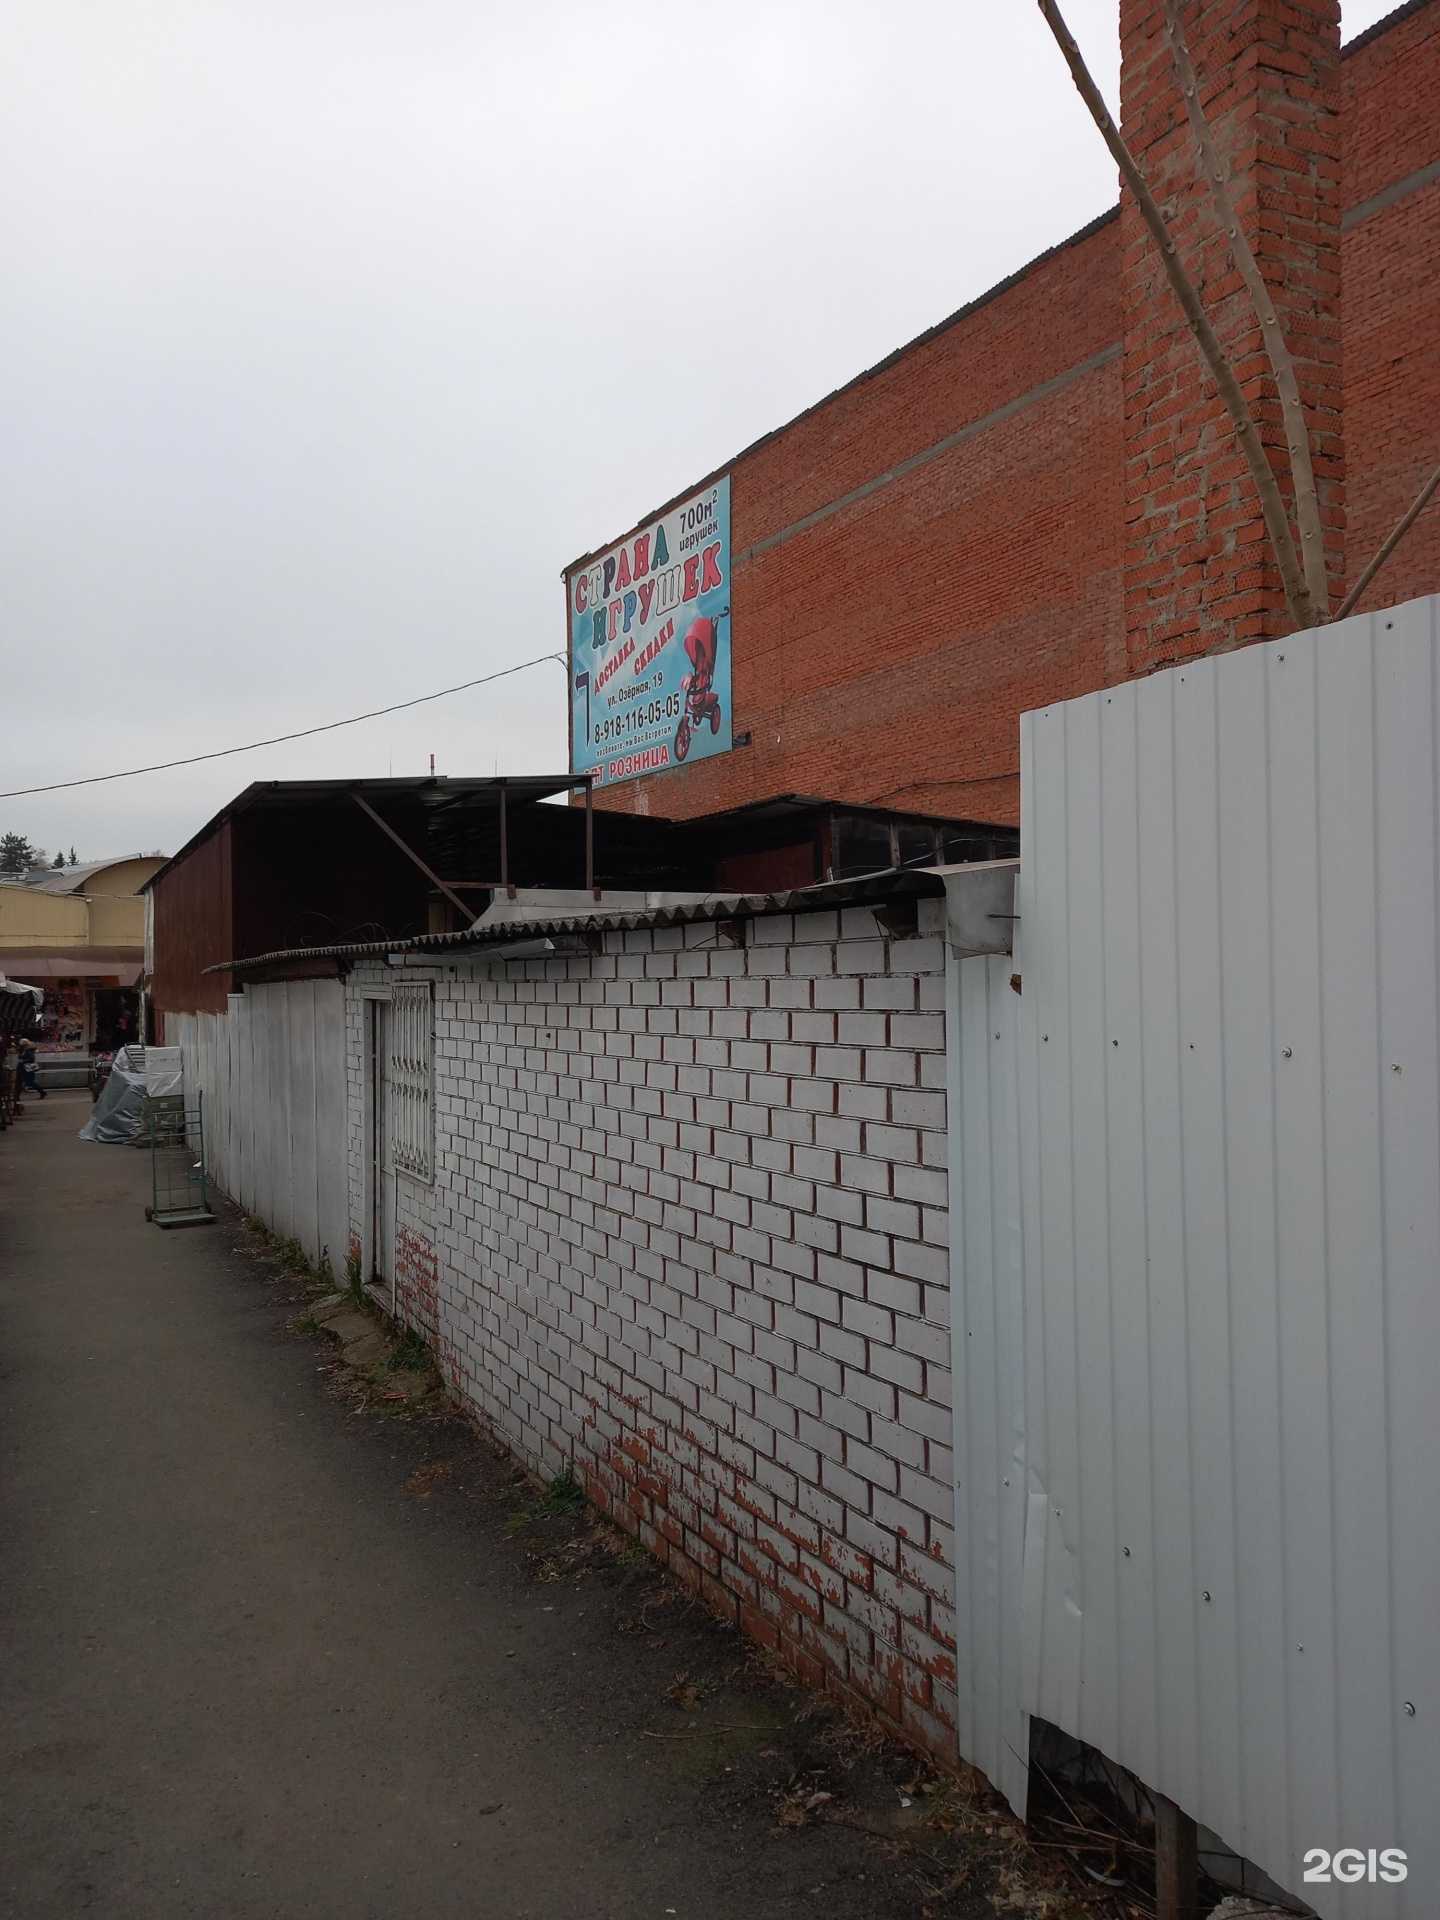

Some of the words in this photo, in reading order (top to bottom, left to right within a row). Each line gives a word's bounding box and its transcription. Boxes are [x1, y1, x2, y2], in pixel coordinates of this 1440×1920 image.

[679, 520, 719, 552] игрушек
[575, 524, 670, 614] СТРАНА
[592, 541, 722, 650] ИГРУШЕК
[594, 636, 635, 696] ДОСТАВКА
[607, 695, 618, 710] ул.
[618, 681, 652, 702] Озёрная,
[653, 671, 663, 687] 19
[594, 692, 680, 745] 8-918-116-05-05
[610, 745, 669, 778] РОЗНИЦА
